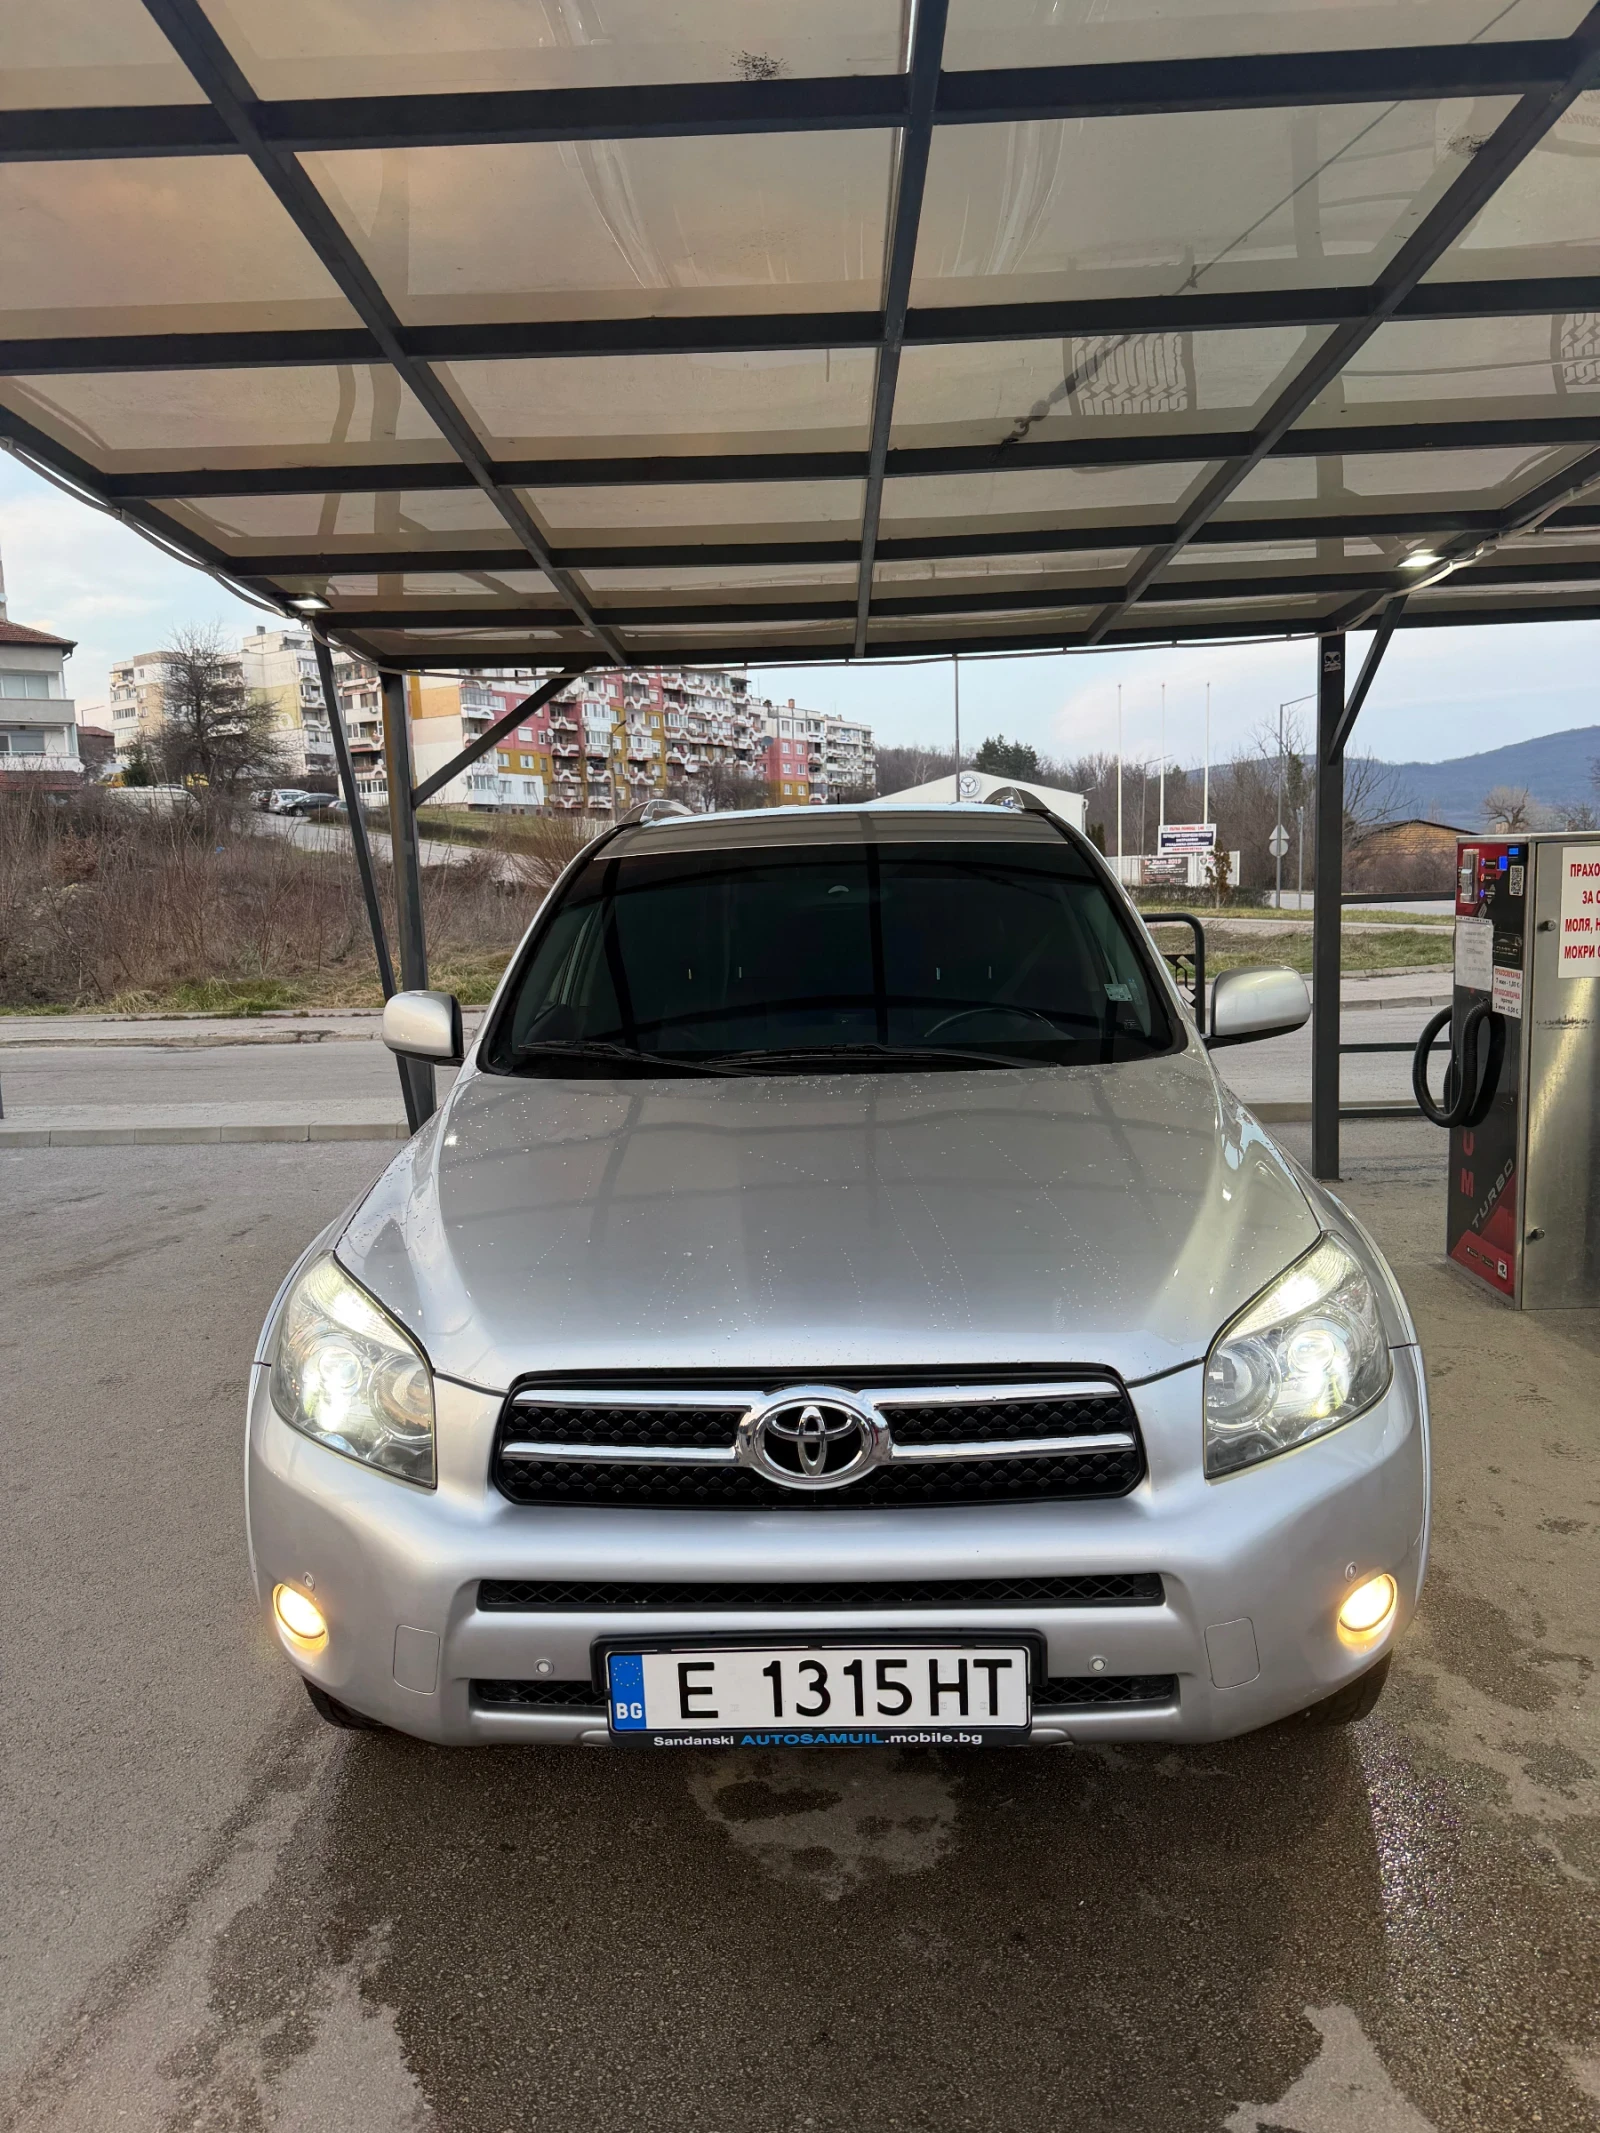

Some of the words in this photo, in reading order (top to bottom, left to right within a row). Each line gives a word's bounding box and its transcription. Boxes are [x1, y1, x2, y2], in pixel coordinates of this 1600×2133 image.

[1582, 890, 1593, 904] ЗА
[1565, 918, 1593, 934] МОЛЯ,
[1564, 945, 1595, 959] МОКРИ
[1472, 1158, 1514, 1229] TURBO
[677, 1662, 719, 1719] E
[616, 1702, 643, 1719] BG
[653, 1736, 734, 1747] Sandanski
